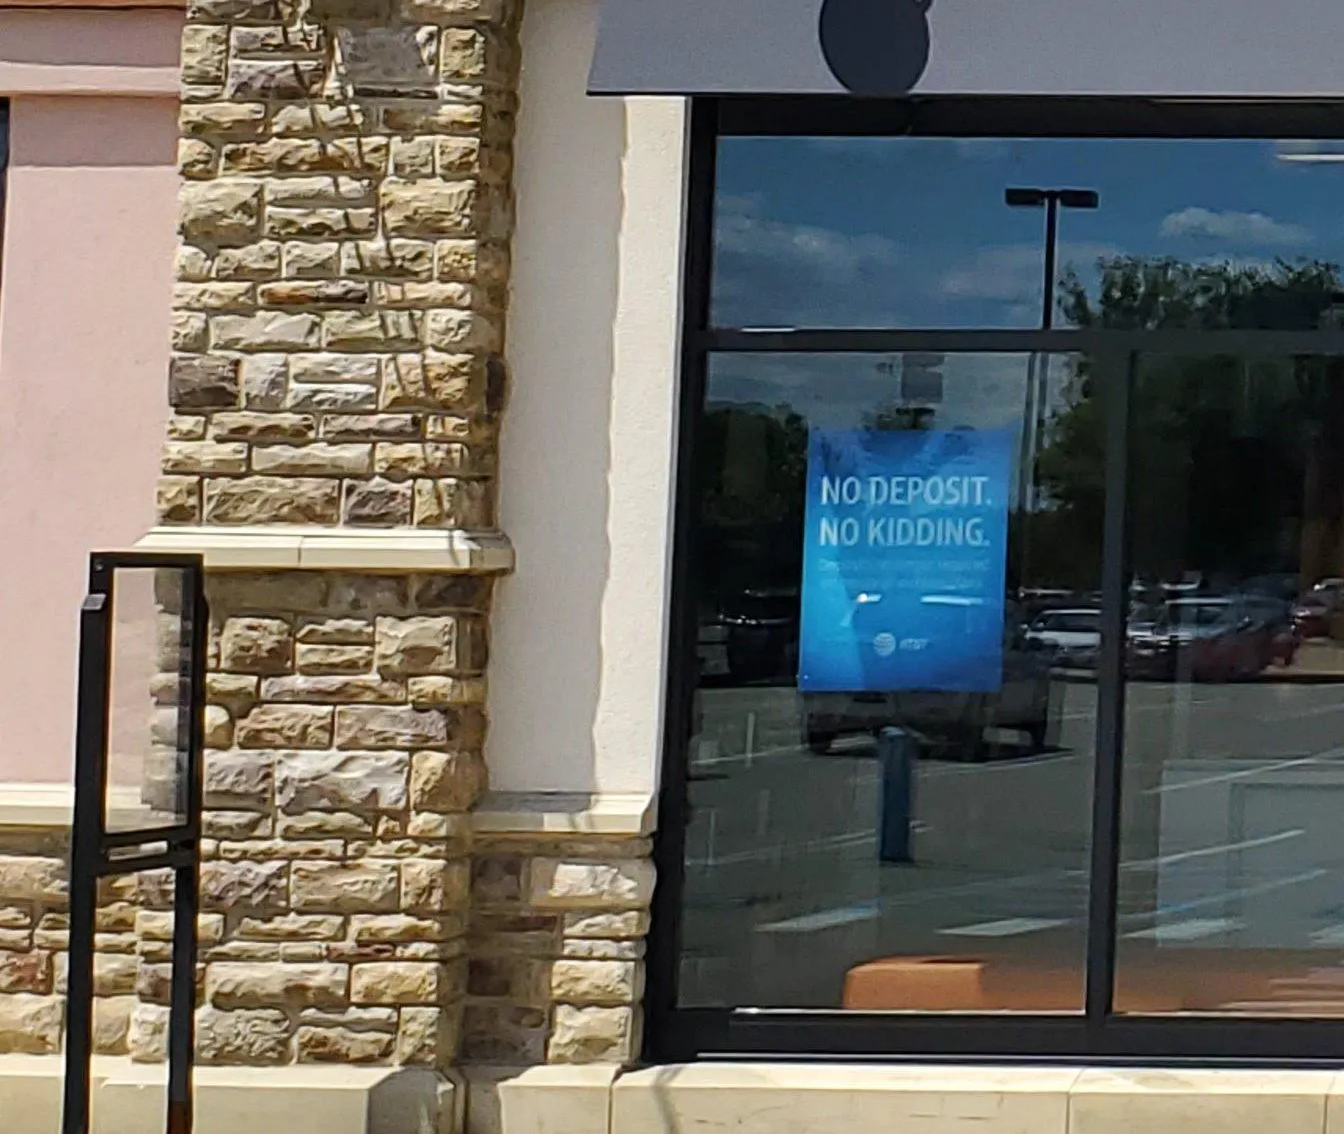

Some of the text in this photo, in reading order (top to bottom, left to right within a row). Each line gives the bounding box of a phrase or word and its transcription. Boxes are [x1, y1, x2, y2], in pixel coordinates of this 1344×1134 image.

[820, 476, 992, 505] NO DEPOSIT.
[819, 517, 991, 546] NO KIDDING.
